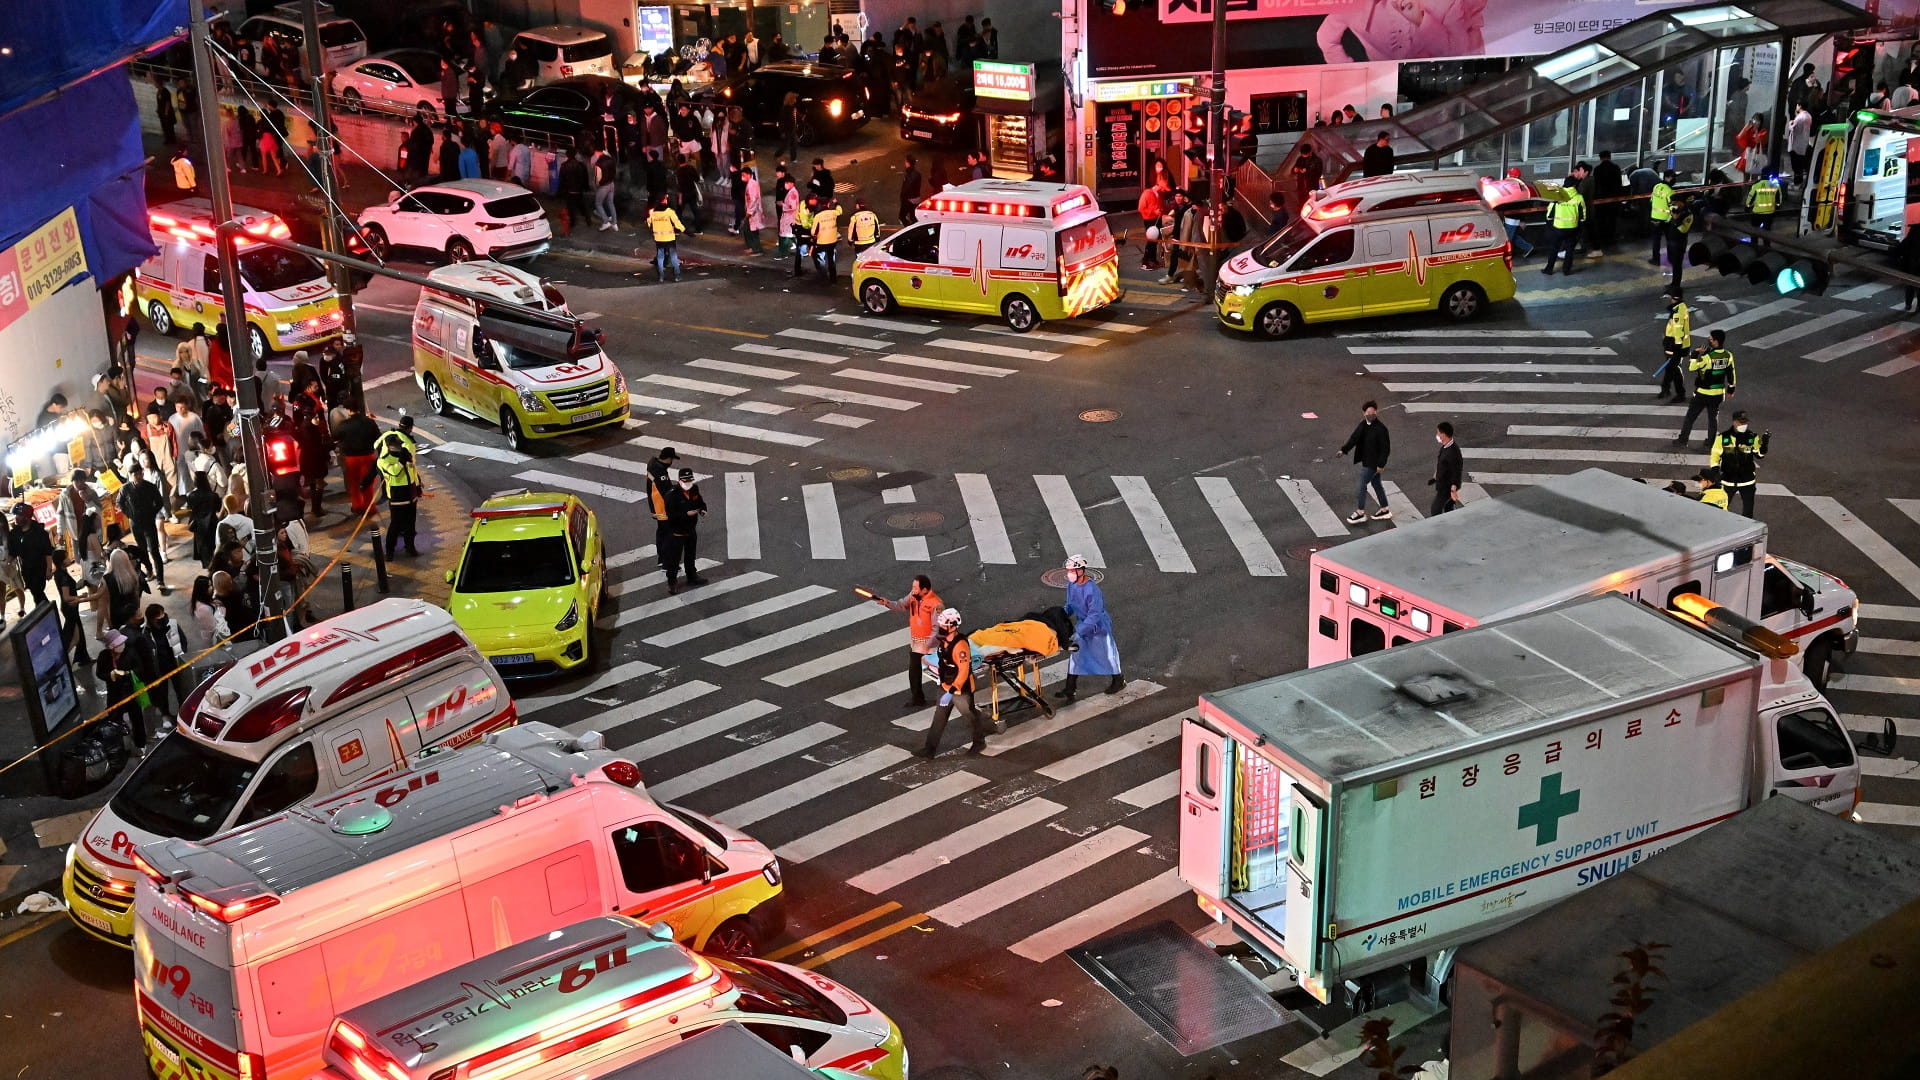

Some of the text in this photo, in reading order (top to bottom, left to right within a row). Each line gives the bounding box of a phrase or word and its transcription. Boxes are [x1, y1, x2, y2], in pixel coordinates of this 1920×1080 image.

[1533, 20, 1577, 34] 핑크문이
[1578, 19, 1600, 32] 뜨면
[20, 217, 76, 272] 문의전화
[1005, 244, 1032, 258] 119
[1438, 223, 1492, 244] 119 구급대
[248, 633, 341, 679] 119 구급대
[426, 684, 468, 732] 119
[340, 742, 361, 761] 구조
[1398, 883, 1455, 911] MOBILE
[1459, 853, 1552, 893] EMERGENCY
[1555, 830, 1622, 864] SUPPORT
[1626, 819, 1660, 842] UNIT
[1577, 855, 1630, 887] SNUH
[152, 906, 206, 950] AMBULANCE
[1378, 921, 1427, 947] 서울특별시
[507, 975, 555, 999] 구급대
[558, 945, 632, 994] 119
[151, 957, 214, 1020] 119 구급대
[160, 1010, 204, 1047] AMBULANCE
